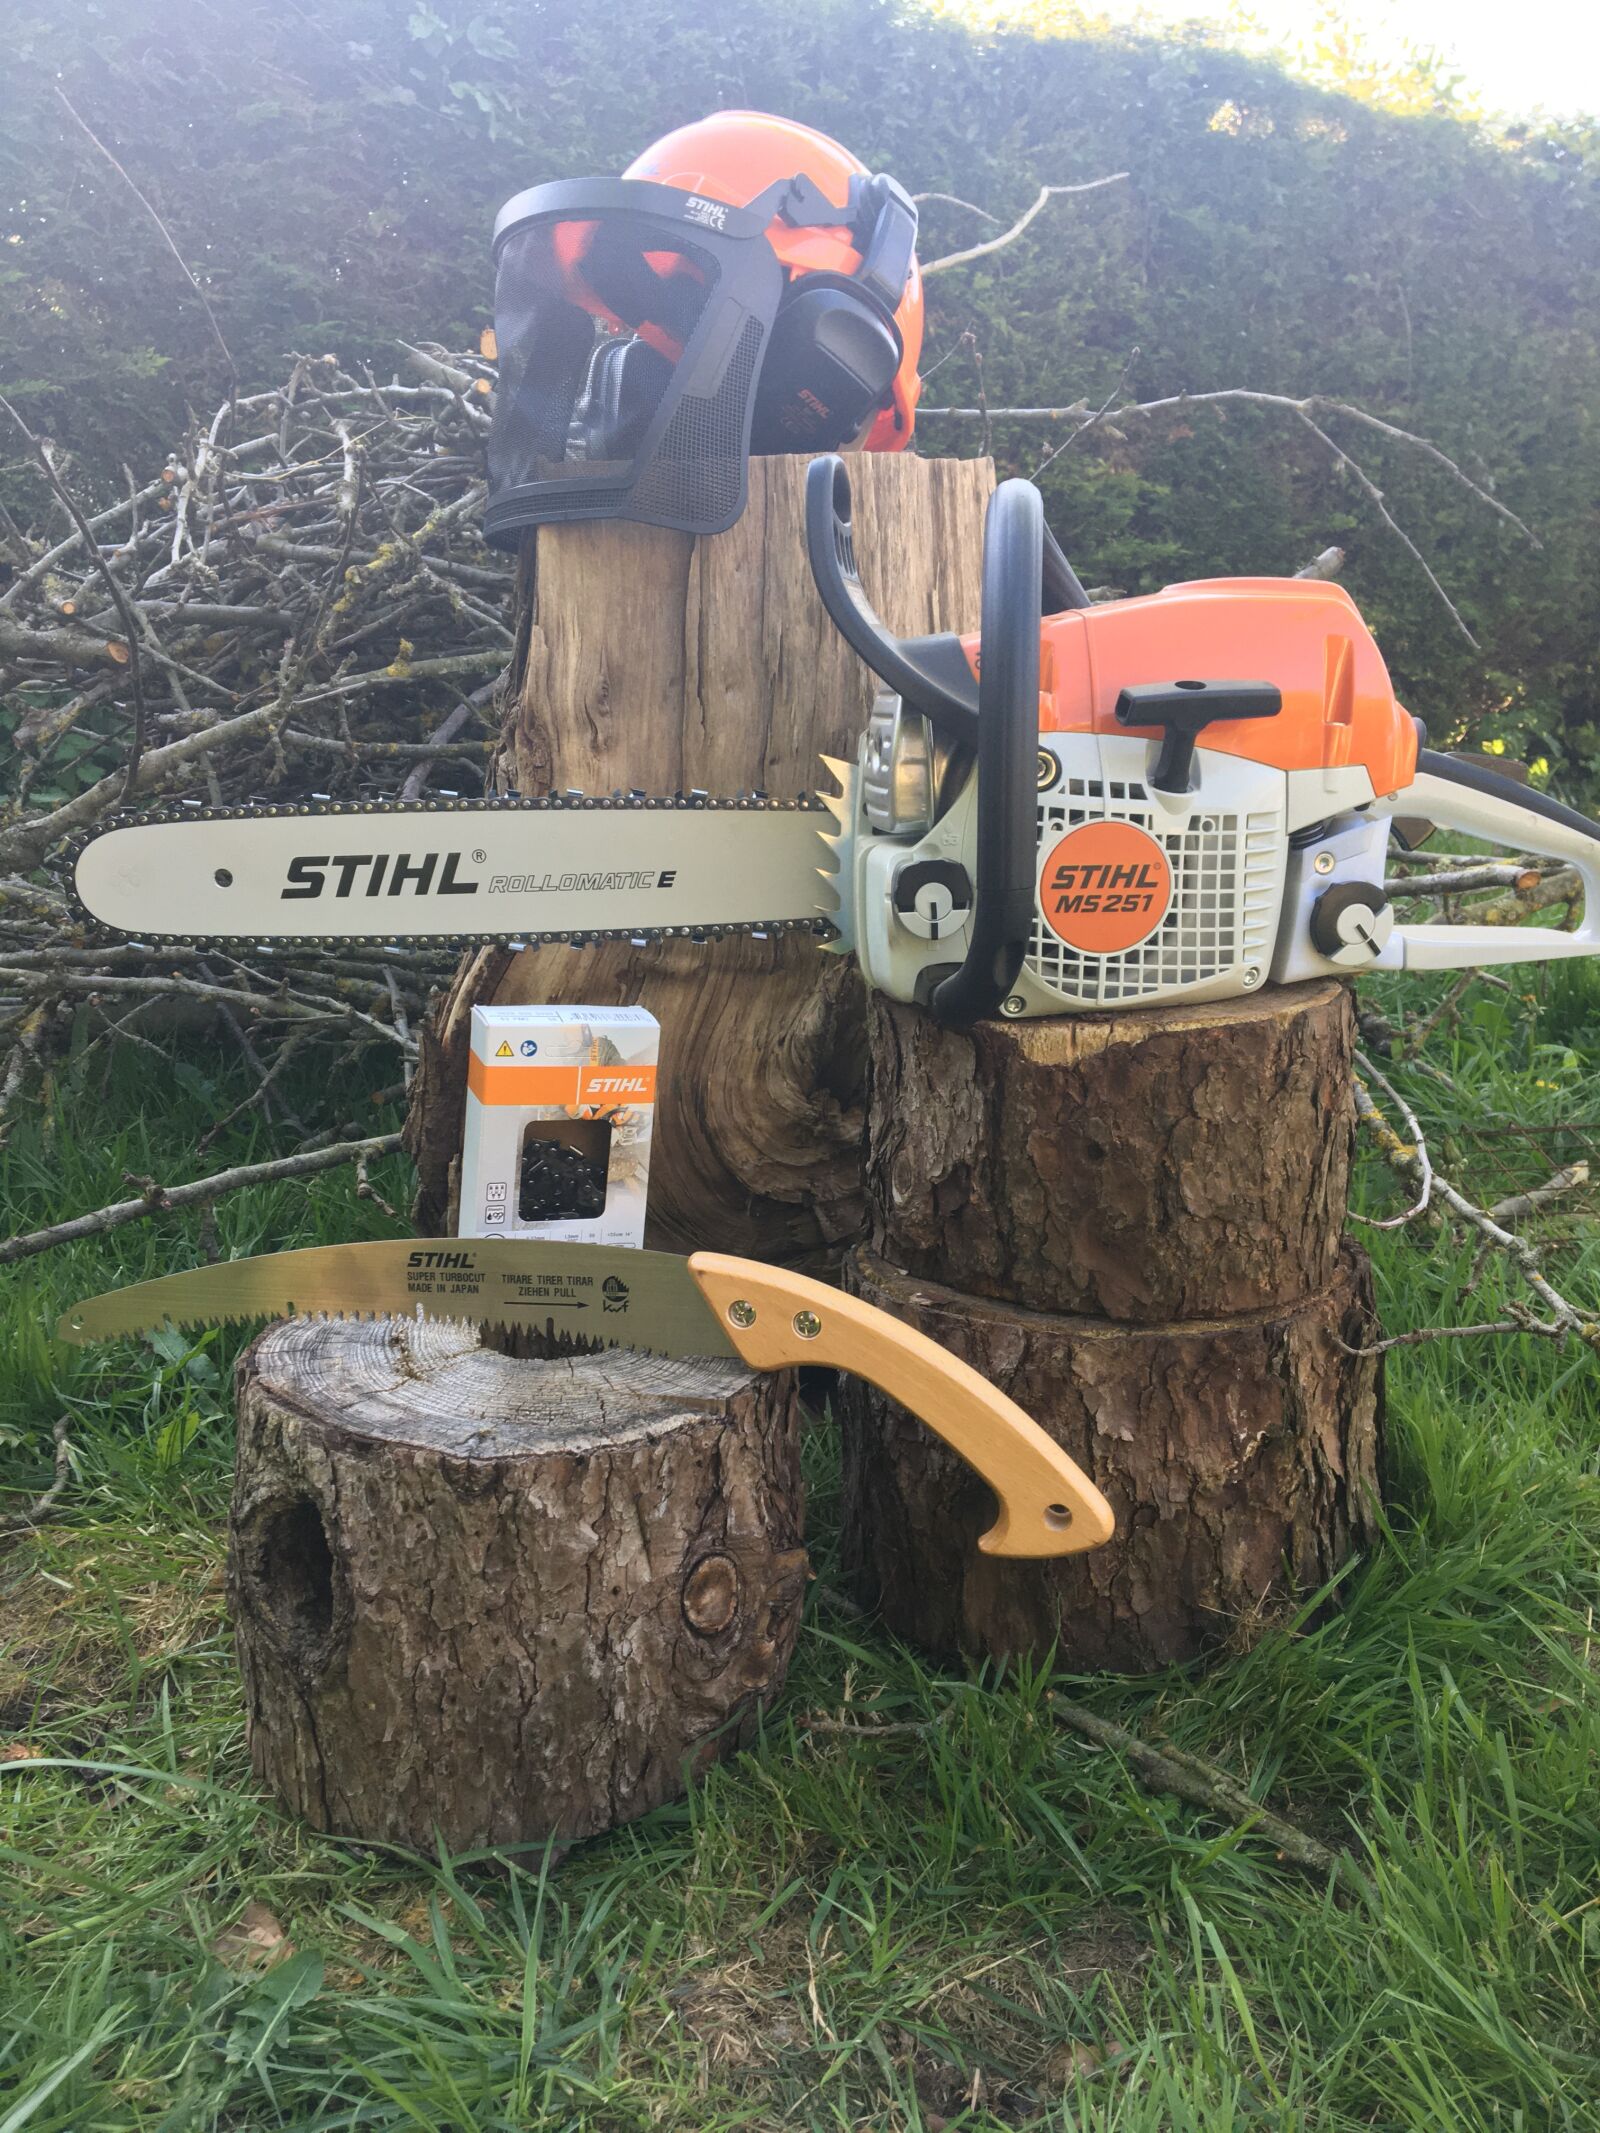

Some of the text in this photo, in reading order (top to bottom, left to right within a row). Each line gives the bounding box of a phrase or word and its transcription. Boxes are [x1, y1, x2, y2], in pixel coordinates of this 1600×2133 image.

[685, 196, 726, 219] STIHL
[797, 388, 830, 418] STIHL
[281, 852, 479, 899] STIHL
[488, 870, 678, 893] ROLLOMATIC E
[1051, 863, 1159, 890] STIHL
[586, 1077, 649, 1093] STIHL
[407, 1252, 475, 1269] STIHL
[407, 1271, 486, 1283] SUPER TURBOCUT
[501, 1274, 594, 1287] TIRARE TIRER TIRAR
[407, 1283, 479, 1294] MADE IN JAPAN
[518, 1286, 577, 1298] ZIEHEN PULL
